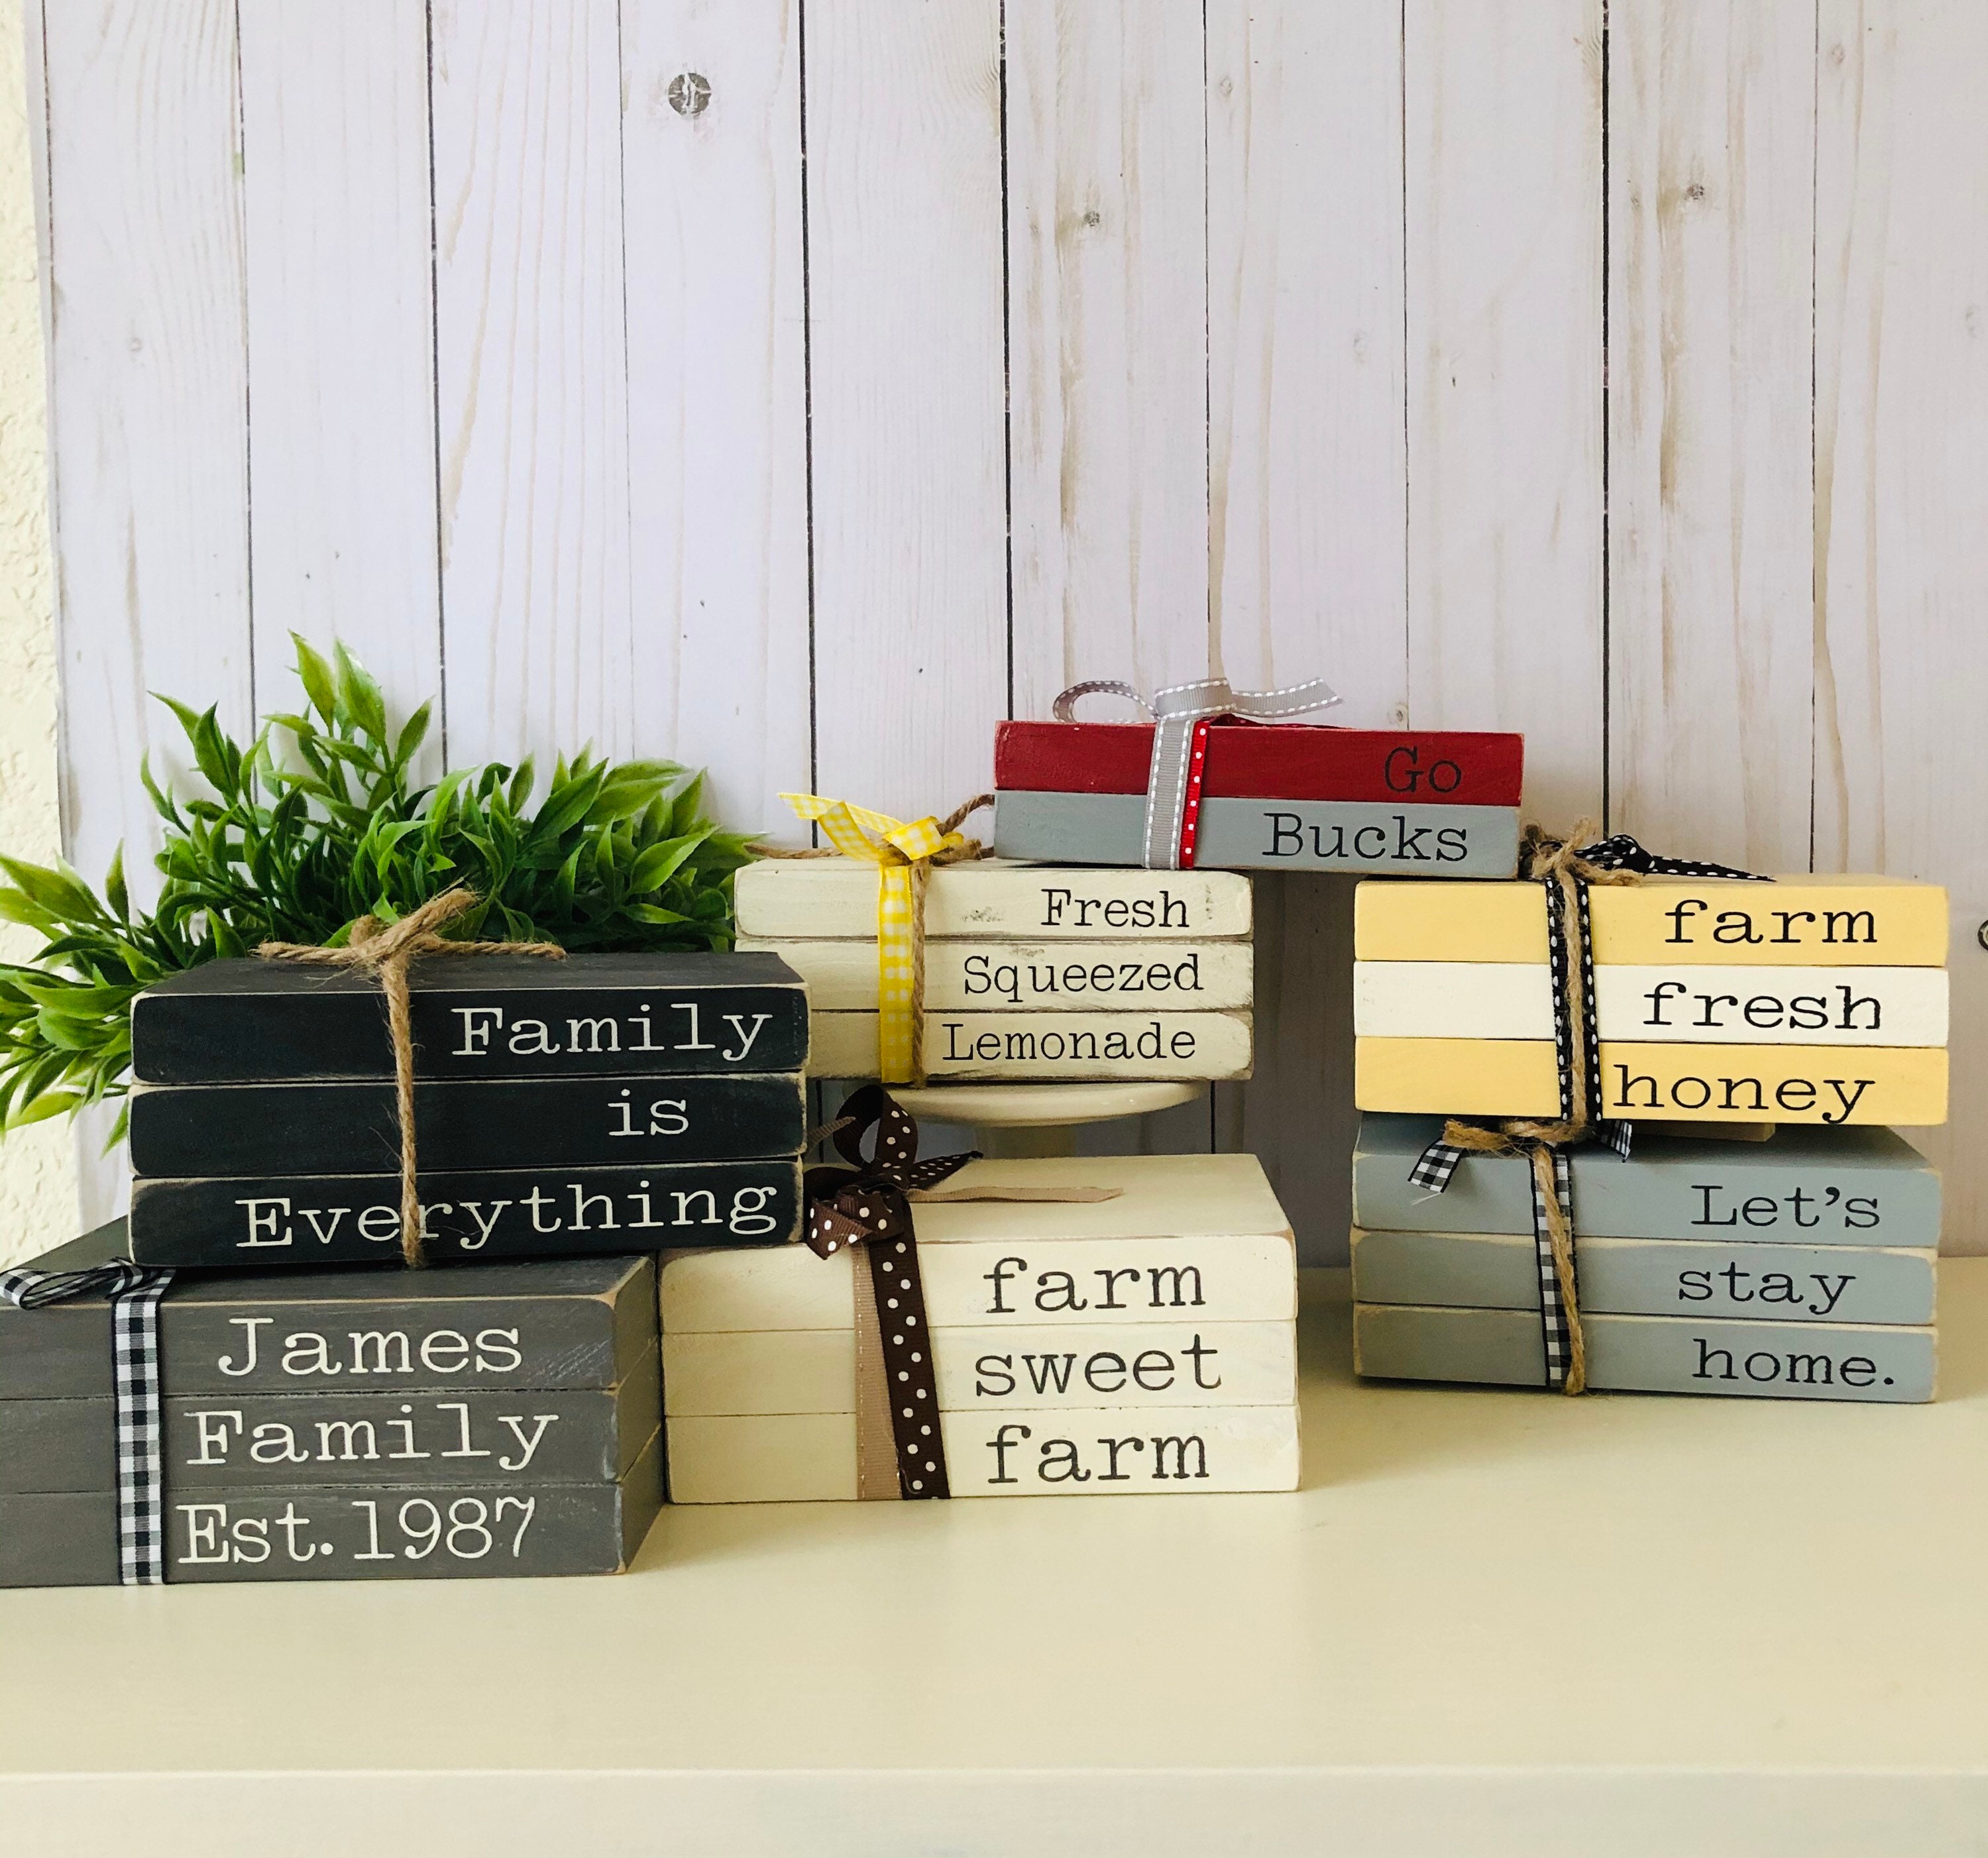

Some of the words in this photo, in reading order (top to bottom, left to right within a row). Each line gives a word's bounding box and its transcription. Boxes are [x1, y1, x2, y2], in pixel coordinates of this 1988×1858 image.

[1384, 745, 1462, 794] Go
[1262, 812, 1469, 864] Bucks
[1040, 889, 1189, 928] Fresh
[1664, 900, 1878, 944] farm
[964, 954, 1203, 1003] Squeezed
[451, 1003, 773, 1061] Family
[1643, 982, 1881, 1030] fresh
[942, 1024, 1196, 1062] Lemonade
[608, 1089, 690, 1138] is
[1613, 1064, 1875, 1124] honey
[235, 1181, 777, 1250] Everything
[1690, 1184, 1881, 1229] Let’s
[983, 1257, 1206, 1313] farm
[1678, 1261, 1856, 1315] stay
[217, 1318, 522, 1378] James
[975, 1333, 1222, 1397] sweet
[1692, 1339, 1893, 1387] home.
[184, 1403, 559, 1470] Family
[986, 1425, 1209, 1484] farm
